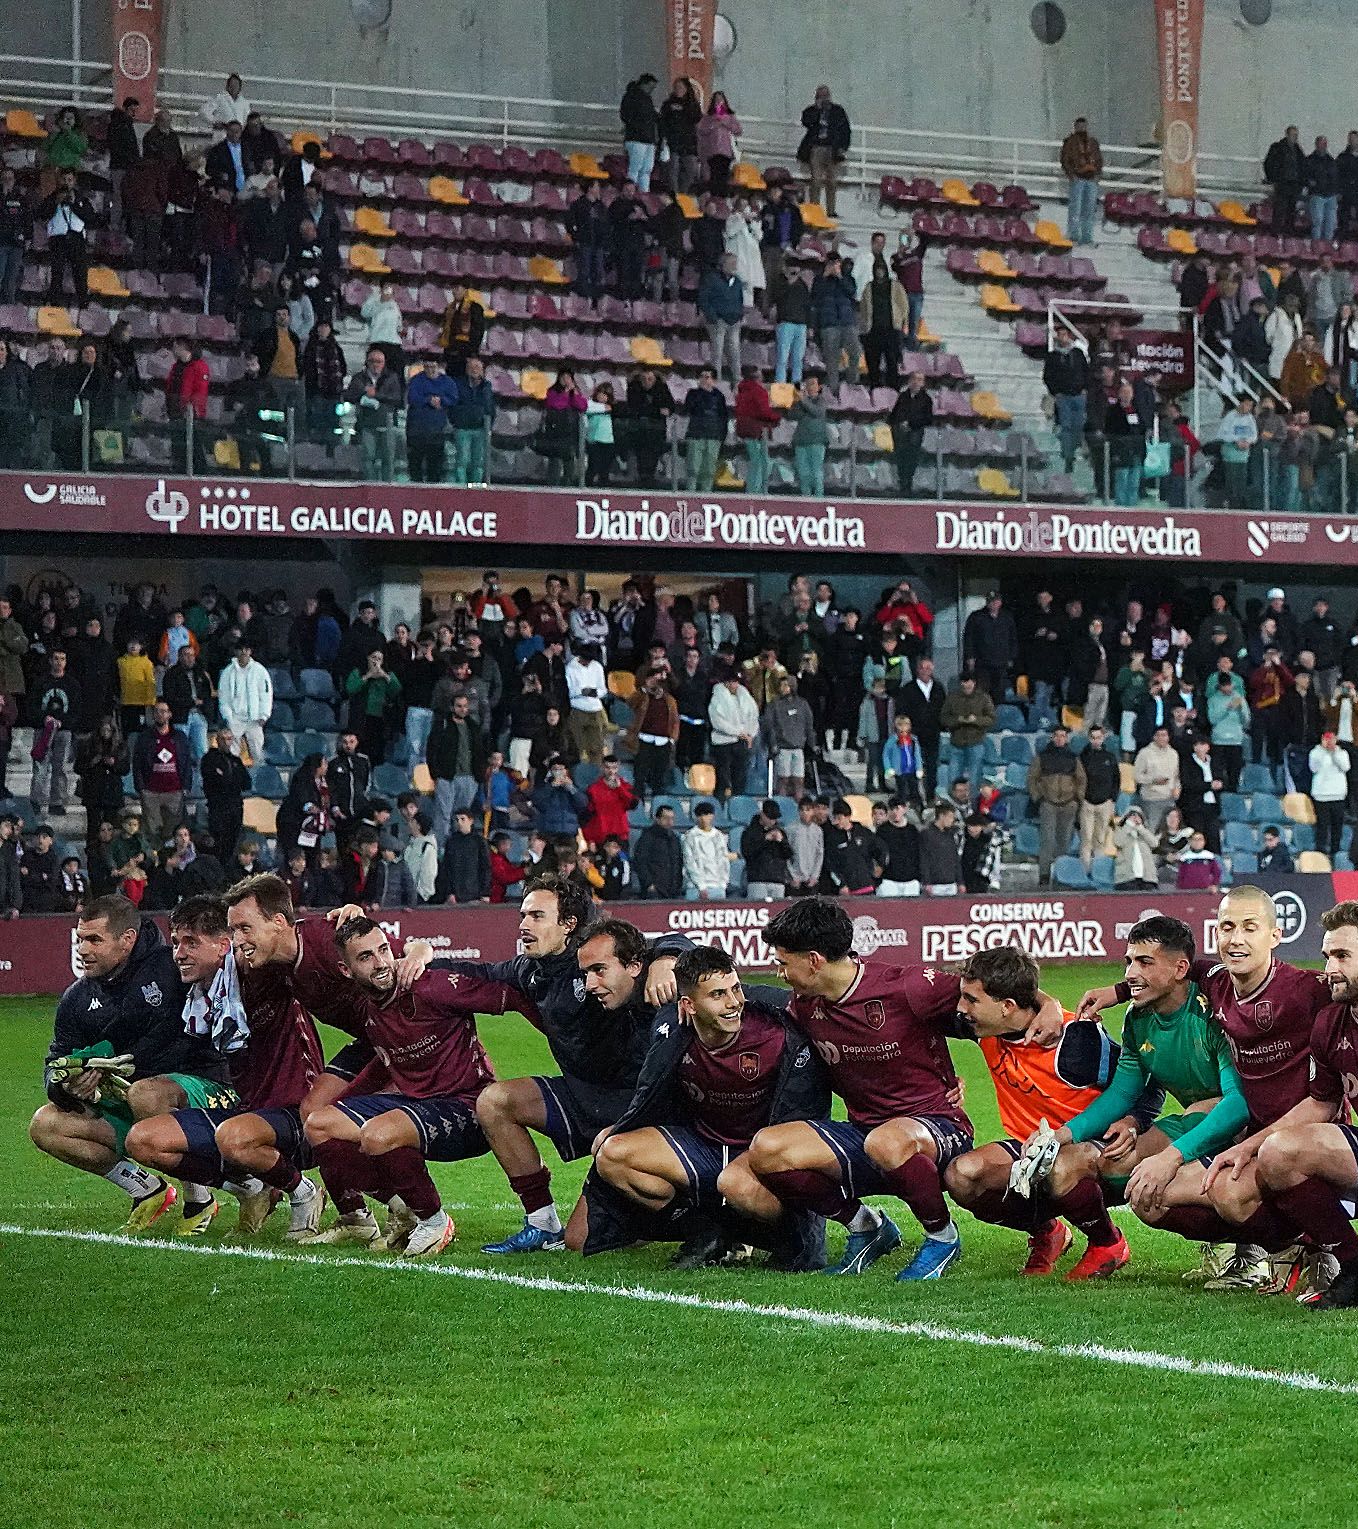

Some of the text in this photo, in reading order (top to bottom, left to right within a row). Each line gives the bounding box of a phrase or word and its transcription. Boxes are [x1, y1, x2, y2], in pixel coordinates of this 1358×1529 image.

[200, 503, 498, 538] HOTEL GALICIA PALACE
[668, 907, 770, 929] CONSERVAS
[970, 902, 1065, 923] CONSERVAS
[921, 923, 1107, 962] PESCAMAR
[842, 1042, 899, 1055] Deputación
